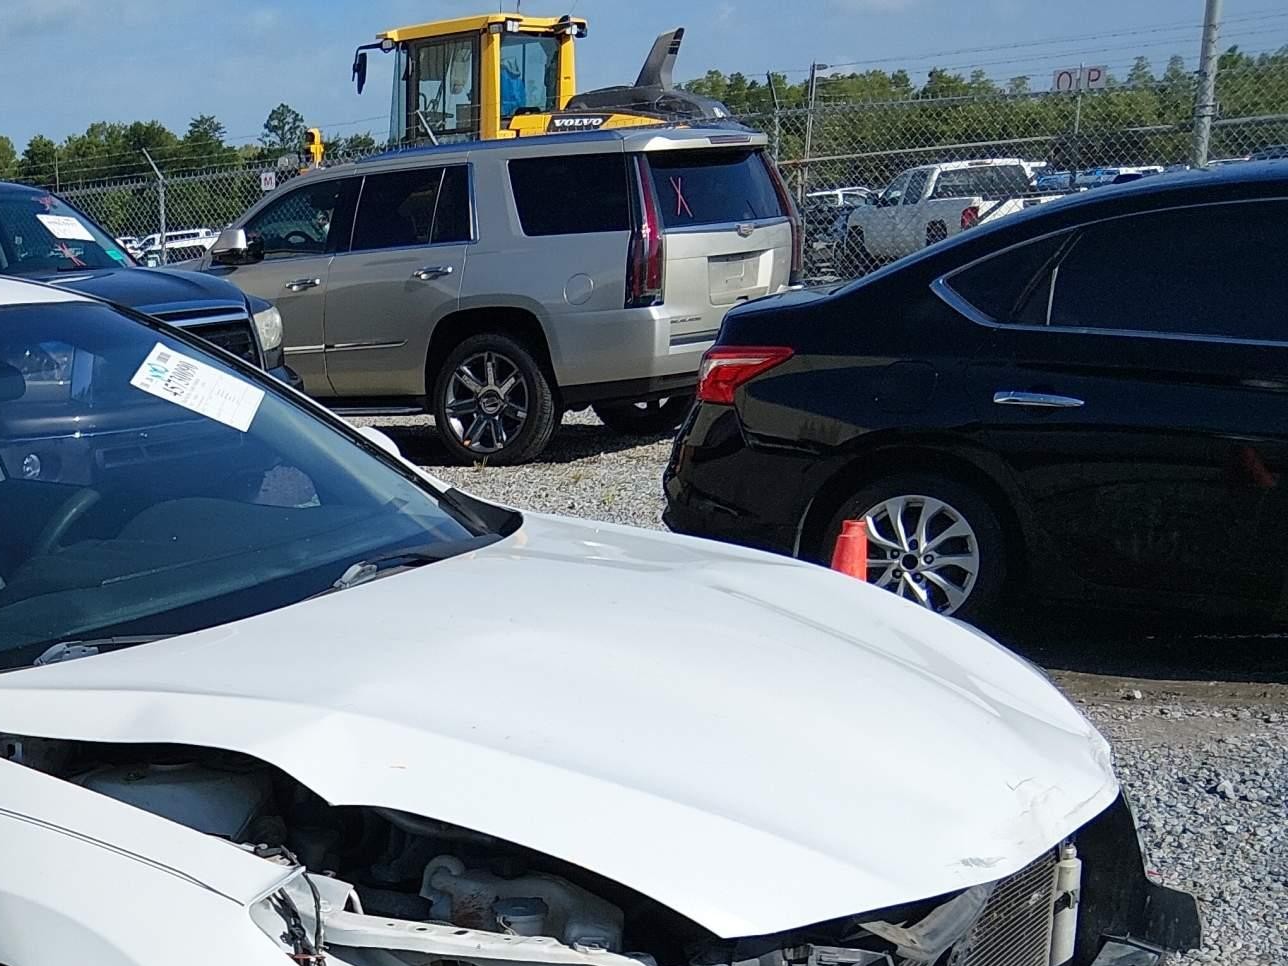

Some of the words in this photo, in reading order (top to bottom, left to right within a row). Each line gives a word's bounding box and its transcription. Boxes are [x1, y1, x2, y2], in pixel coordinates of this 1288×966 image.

[1088, 68, 1101, 88] P
[553, 117, 603, 128] VOLVO
[264, 176, 273, 187] M
[163, 360, 199, 396] 45730090
